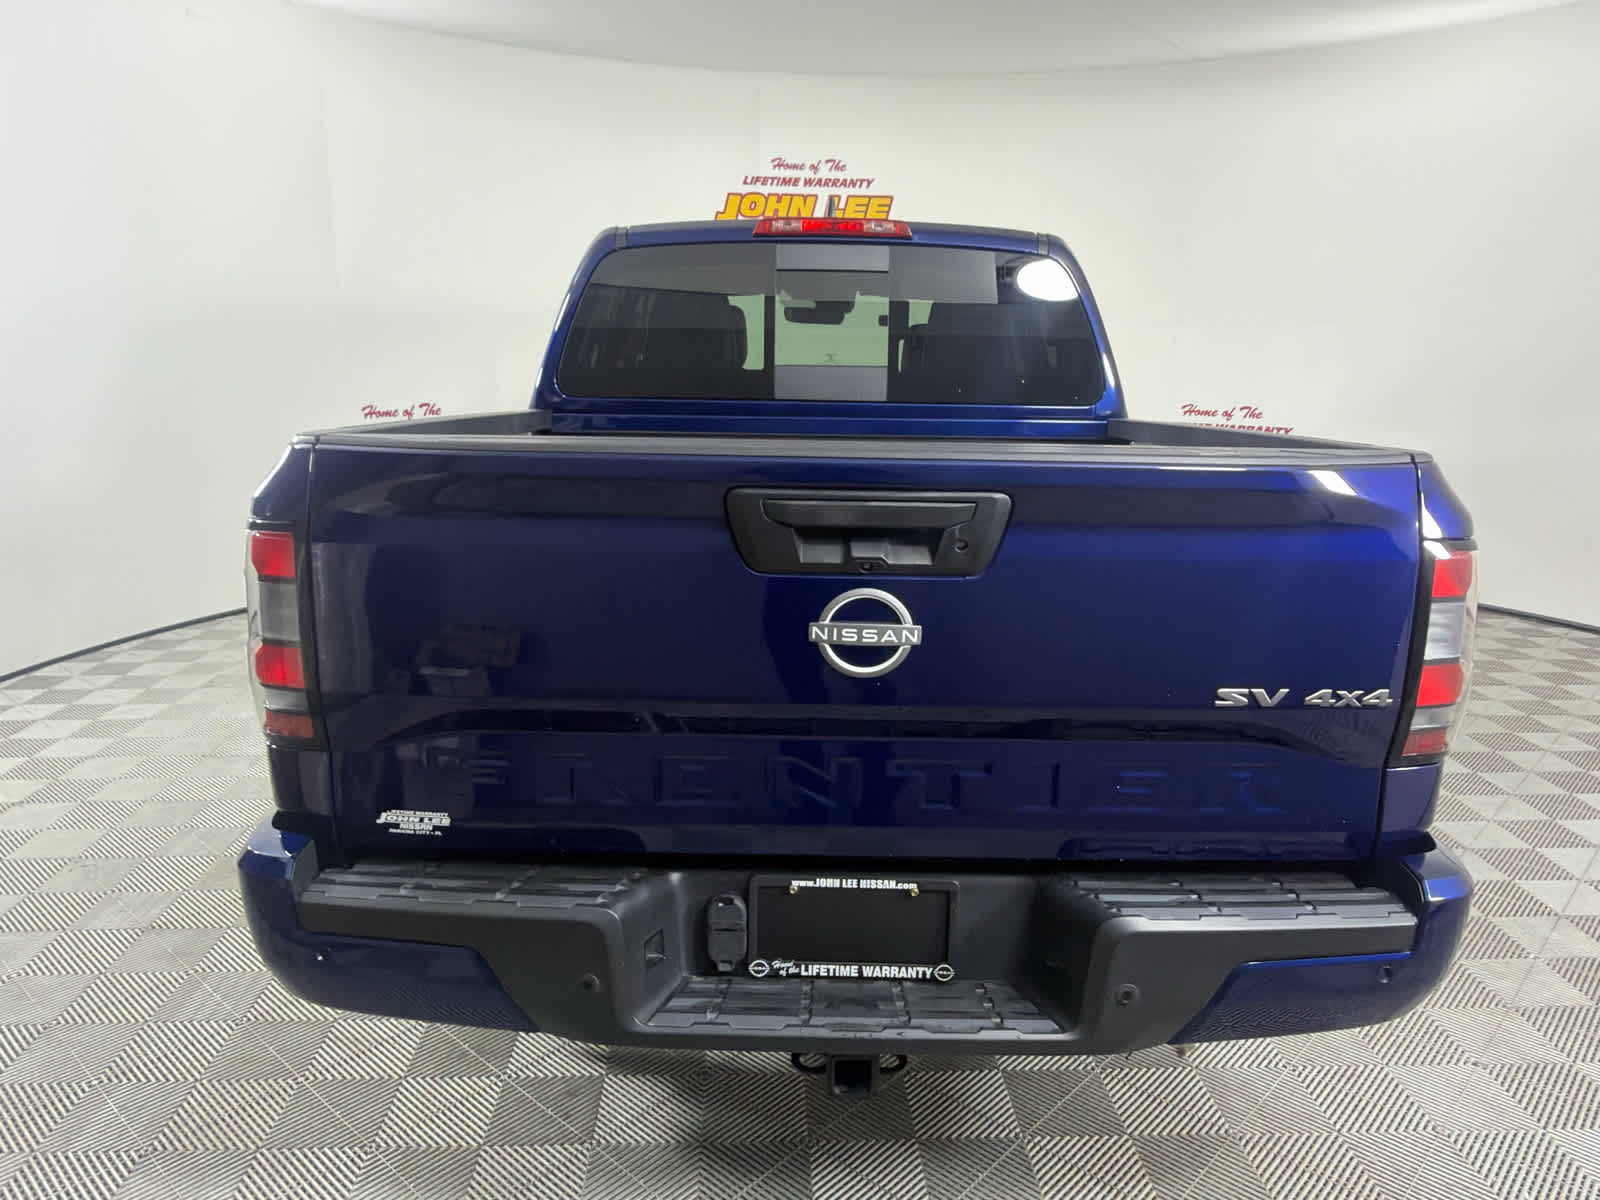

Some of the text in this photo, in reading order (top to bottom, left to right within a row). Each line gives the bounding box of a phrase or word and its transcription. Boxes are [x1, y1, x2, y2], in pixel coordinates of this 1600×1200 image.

[771, 157, 847, 175] Home of The
[742, 175, 876, 189] LIFETIME WARRANTY
[715, 192, 818, 220] JOHN
[361, 403, 441, 420] Home of The
[1181, 403, 1263, 421] Home of The
[811, 626, 919, 643] NISSAN
[1214, 688, 1290, 707] SV
[376, 812, 451, 826] JOHN LEE
[842, 879, 858, 888] LEE
[860, 880, 918, 889] NISSAN.com
[801, 964, 859, 977] LIFETIME
[862, 965, 933, 979] WARRANTY
